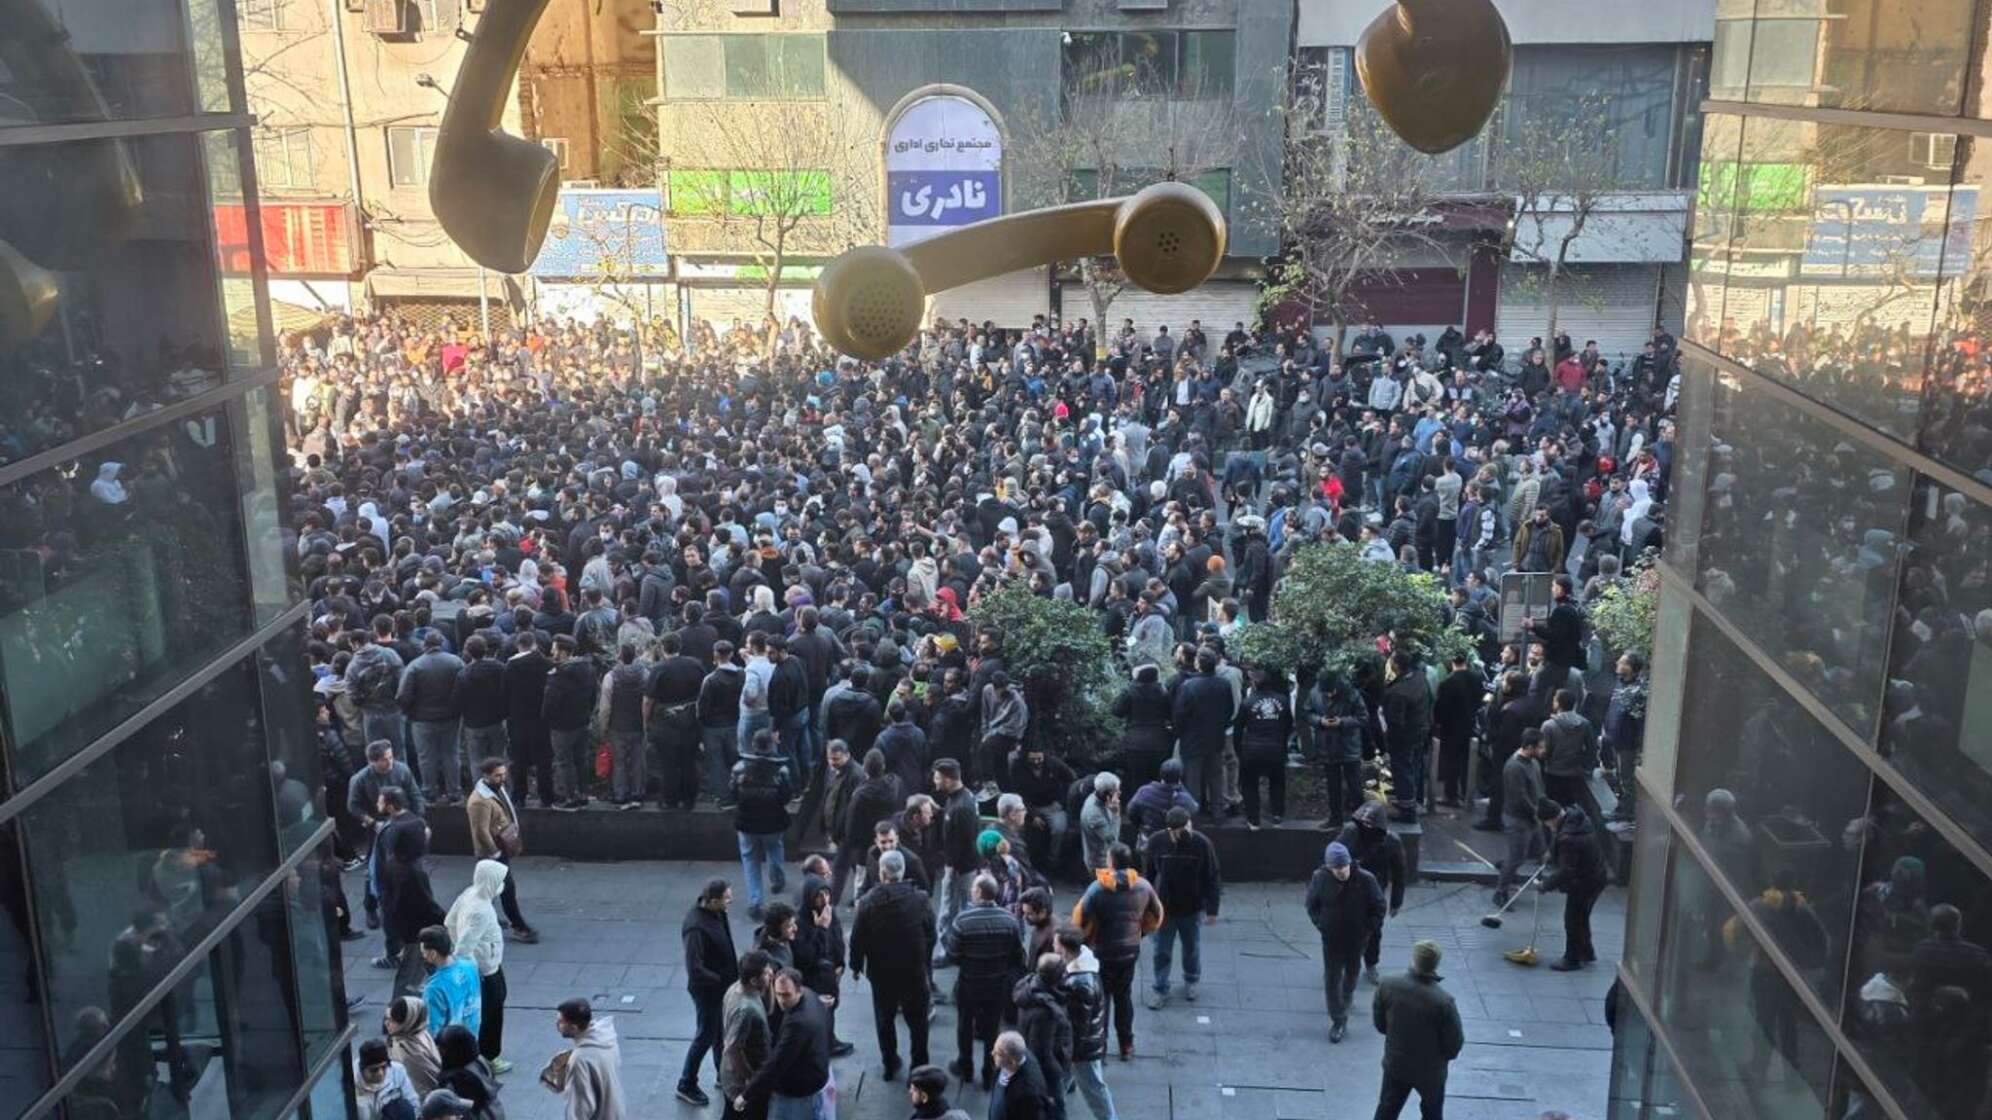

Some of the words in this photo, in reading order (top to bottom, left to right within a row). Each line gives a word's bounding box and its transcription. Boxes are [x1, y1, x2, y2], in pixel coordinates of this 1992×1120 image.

[894, 138, 922, 153] اداری
[924, 137, 955, 153] تجاری
[956, 137, 992, 153] مجتمع
[901, 179, 987, 221] نادری
